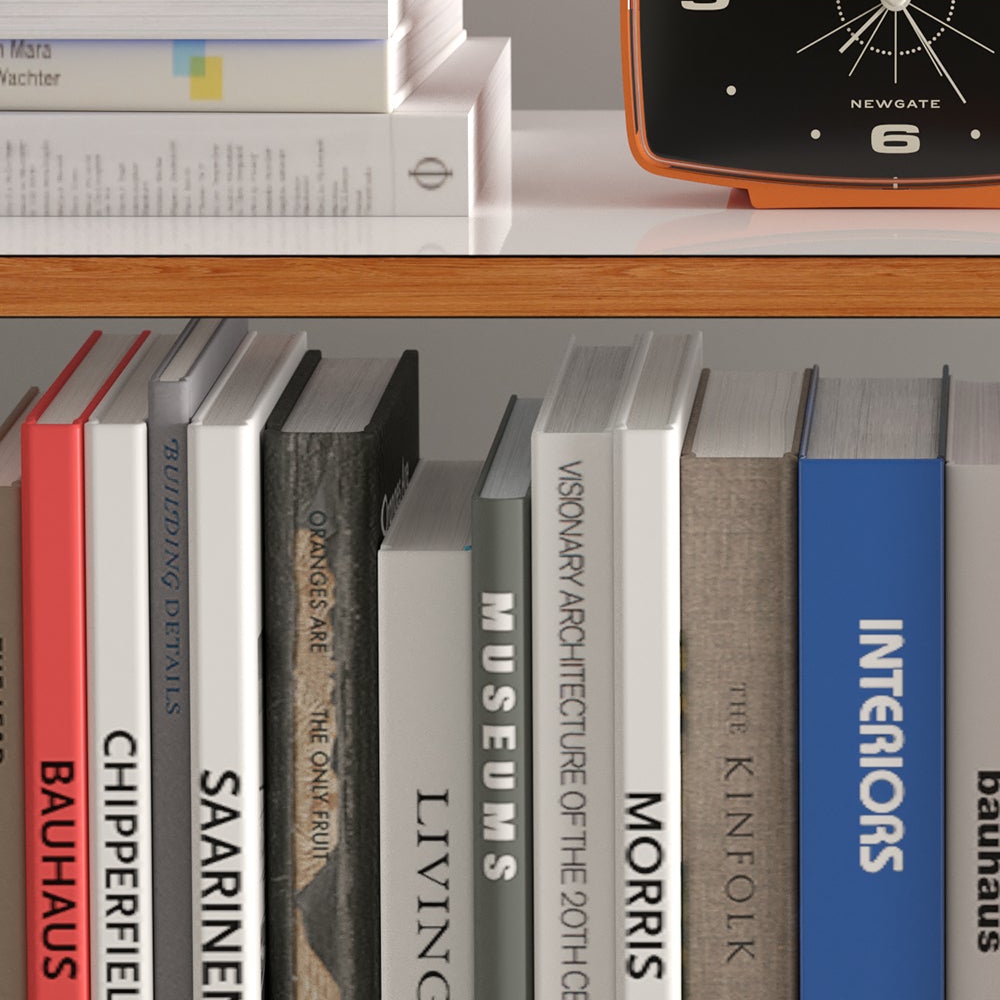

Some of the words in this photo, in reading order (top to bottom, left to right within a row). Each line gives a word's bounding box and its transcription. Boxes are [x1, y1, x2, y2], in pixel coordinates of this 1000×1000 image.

[11, 39, 52, 59] Mara
[850, 99, 941, 109] NEWGATE
[870, 123, 921, 154] 6
[161, 439, 181, 591] BUILDING
[557, 460, 585, 587] VISIONARY
[308, 510, 328, 610] ORANGES
[165, 599, 181, 715] DETAILS
[310, 616, 328, 653] ARE
[311, 709, 329, 743] THE
[559, 590, 587, 786] ARCHITECTURE
[728, 681, 747, 735] THE
[311, 751, 330, 803] ONLY
[481, 592, 518, 881] MUSEUMS
[858, 619, 905, 873] INTERIORS
[312, 808, 330, 861] FRUIT
[560, 790, 587, 826] OF
[40, 760, 77, 980] BAUHAUS
[200, 770, 243, 1000] SAARINE
[560, 837, 588, 885] THE
[625, 792, 666, 981] MORRIS
[724, 756, 756, 963] KINFOLK
[560, 891, 589, 965] 20TH
